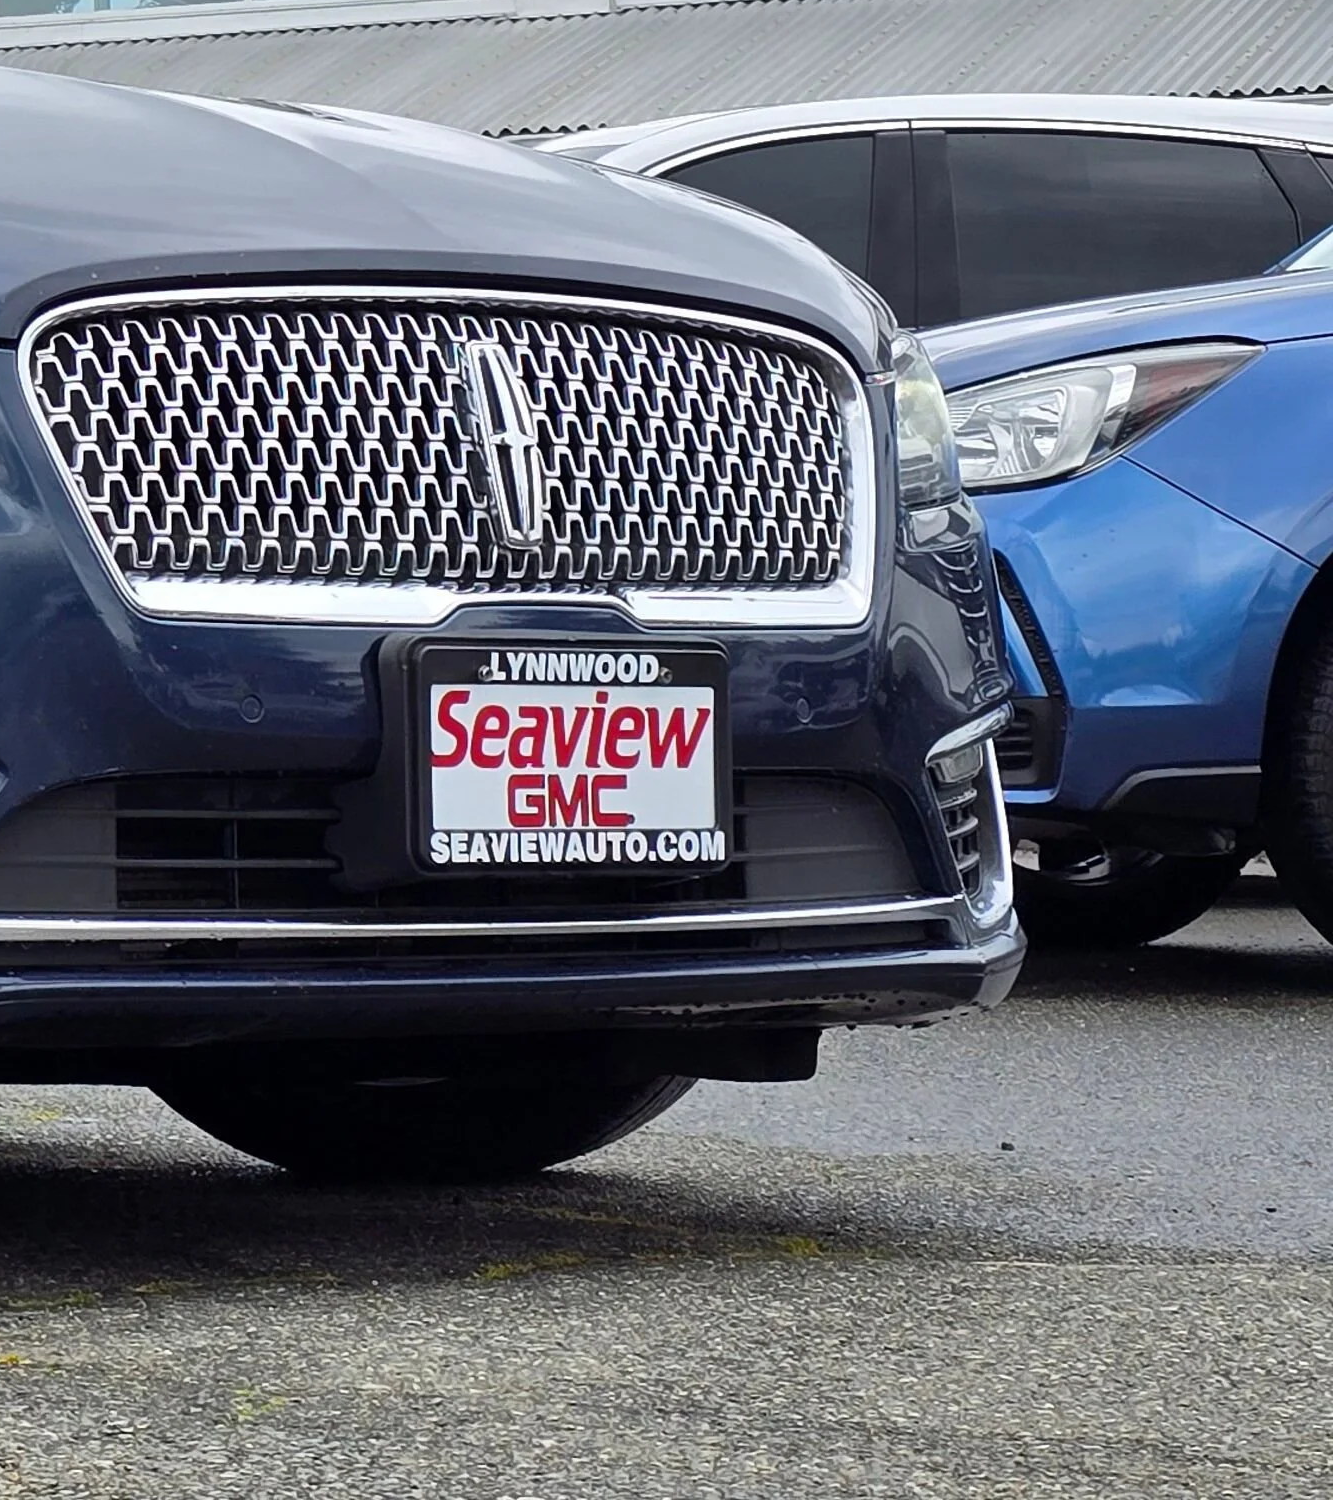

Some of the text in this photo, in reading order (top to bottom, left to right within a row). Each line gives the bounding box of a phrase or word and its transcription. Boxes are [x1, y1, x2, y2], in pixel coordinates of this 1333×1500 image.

[489, 651, 660, 684] LYNNWOOD
[430, 689, 711, 770] Seaview
[507, 773, 629, 828] GMC
[430, 830, 726, 864] SEAVIEWAUTO.COM
